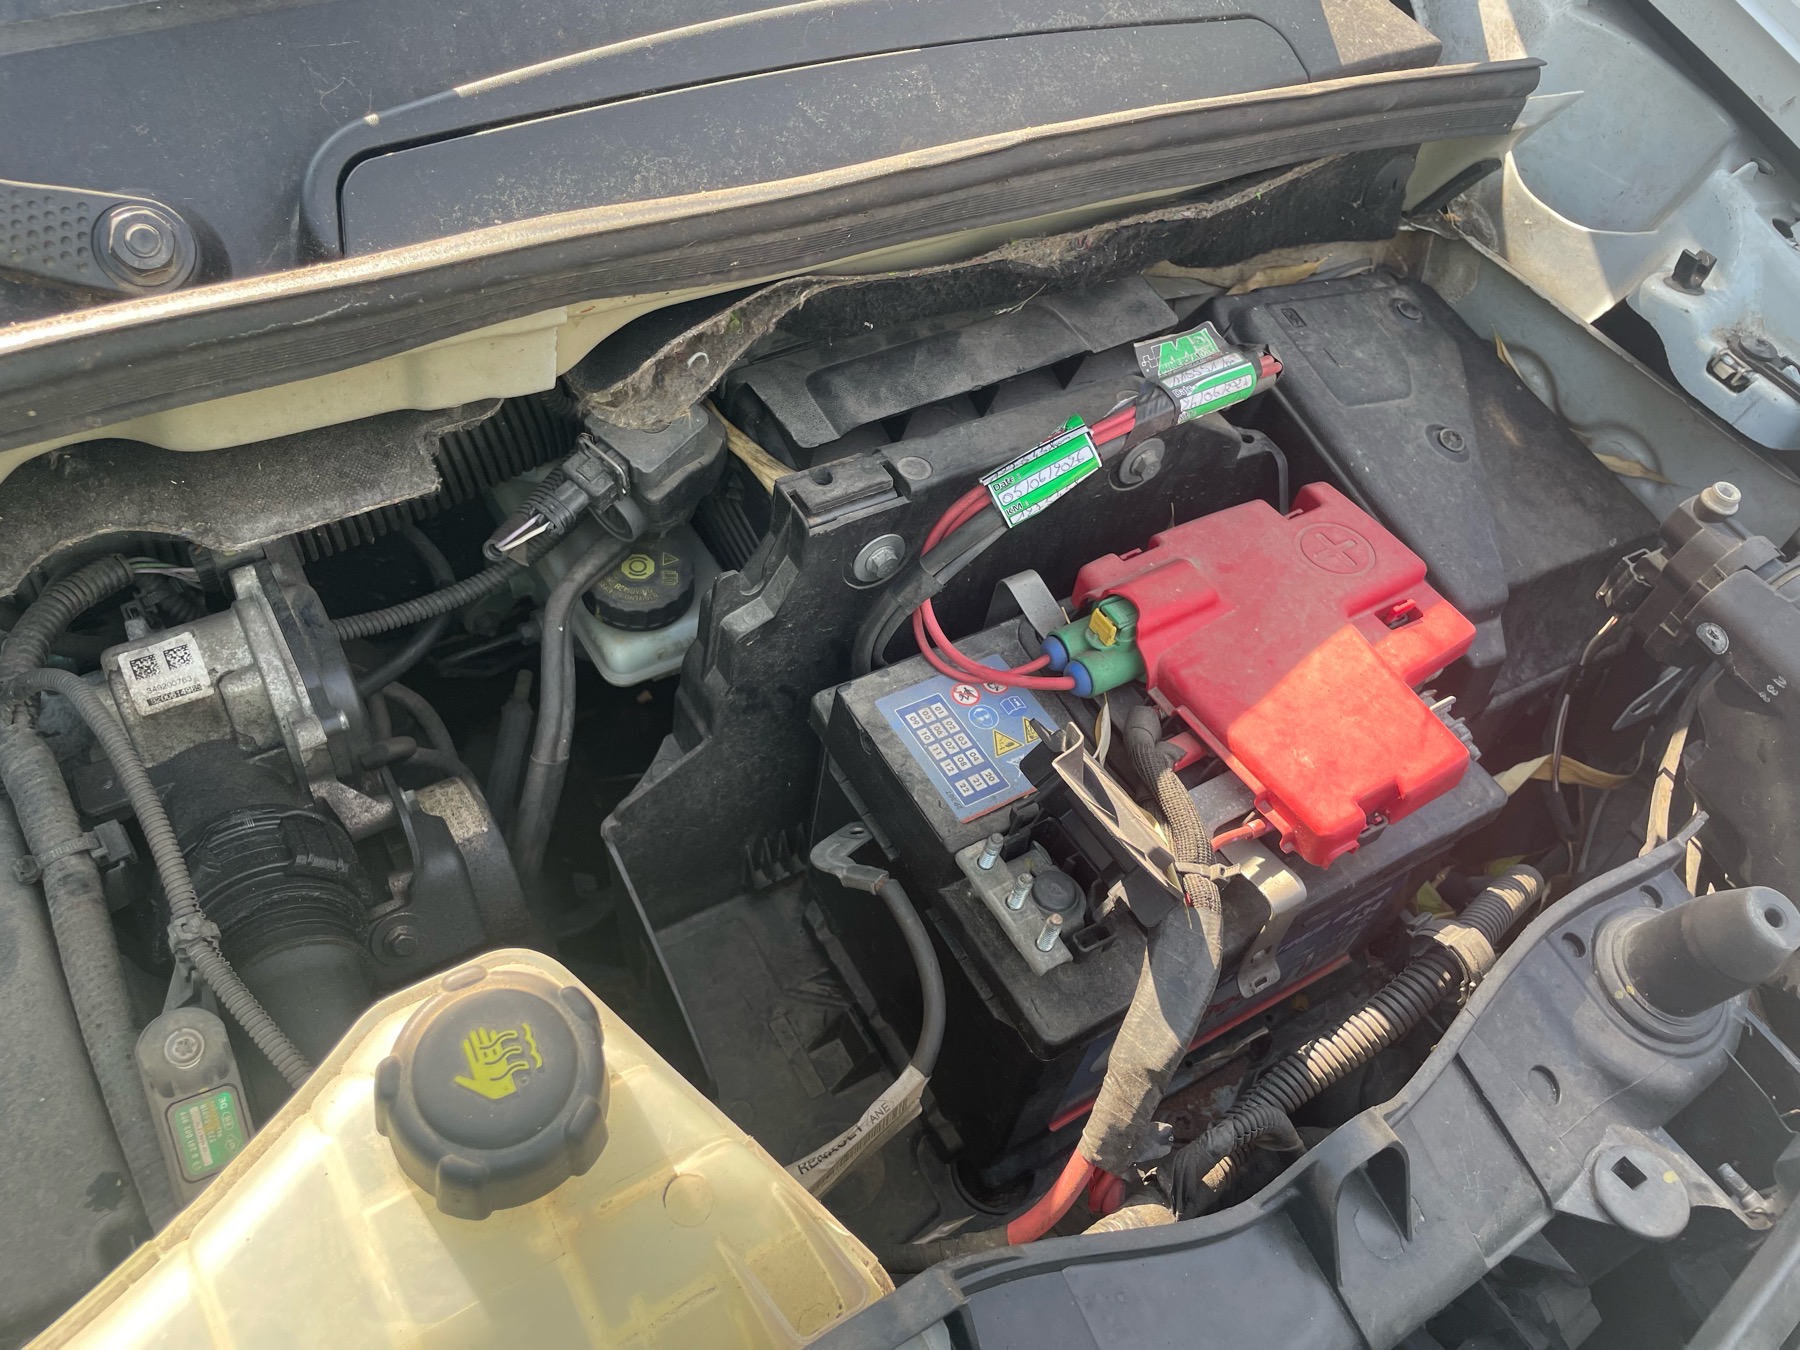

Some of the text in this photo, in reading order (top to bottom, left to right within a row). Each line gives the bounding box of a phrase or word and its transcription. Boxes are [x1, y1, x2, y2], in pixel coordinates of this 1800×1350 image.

[910, 716, 970, 793] 09 10 11 12 22
[922, 710, 982, 787] 05 06 07 08 21
[934, 706, 996, 782] 01 02 03 04 20
